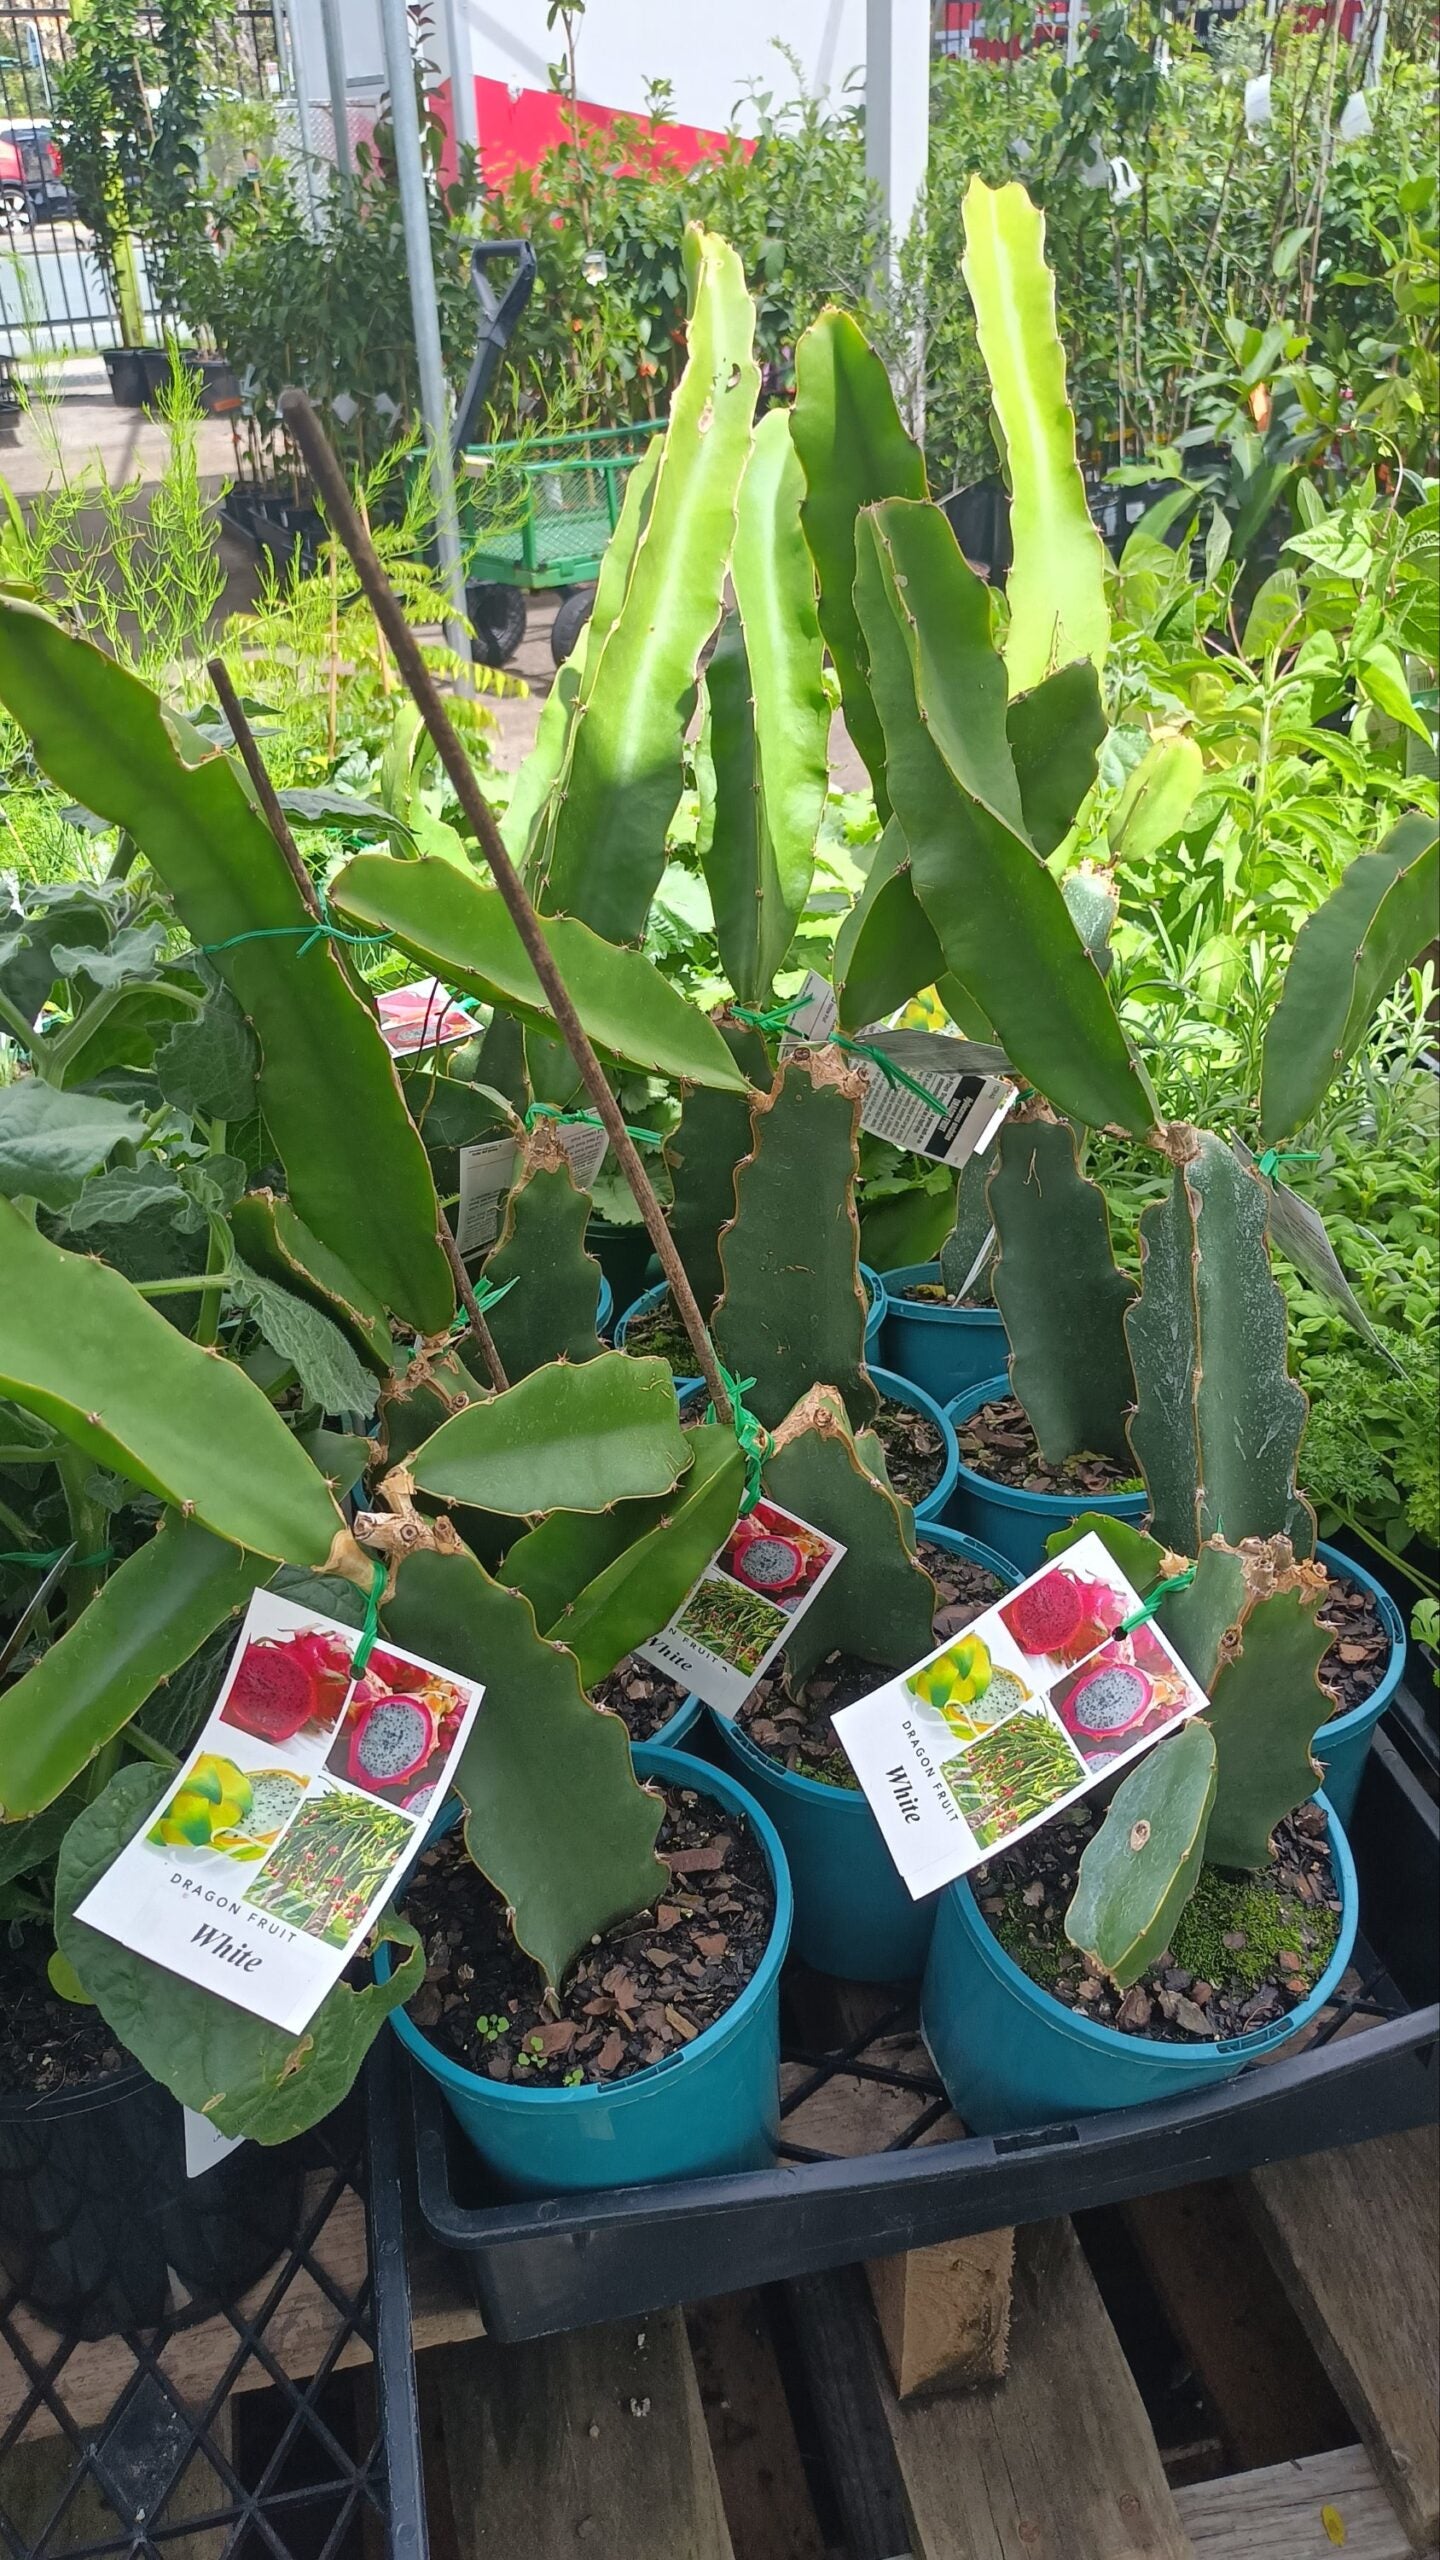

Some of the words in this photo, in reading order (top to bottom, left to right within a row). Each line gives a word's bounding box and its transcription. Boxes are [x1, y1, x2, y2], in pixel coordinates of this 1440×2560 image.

[682, 1637, 718, 1663] FRUIT
[886, 1765, 920, 1824] White
[902, 1720, 935, 1777] DRAGON
[932, 1782, 959, 1822] FRUIT
[170, 1873, 242, 1915] DRAGON
[247, 1912, 299, 1943] FRUIT
[190, 1922, 263, 1972] White
